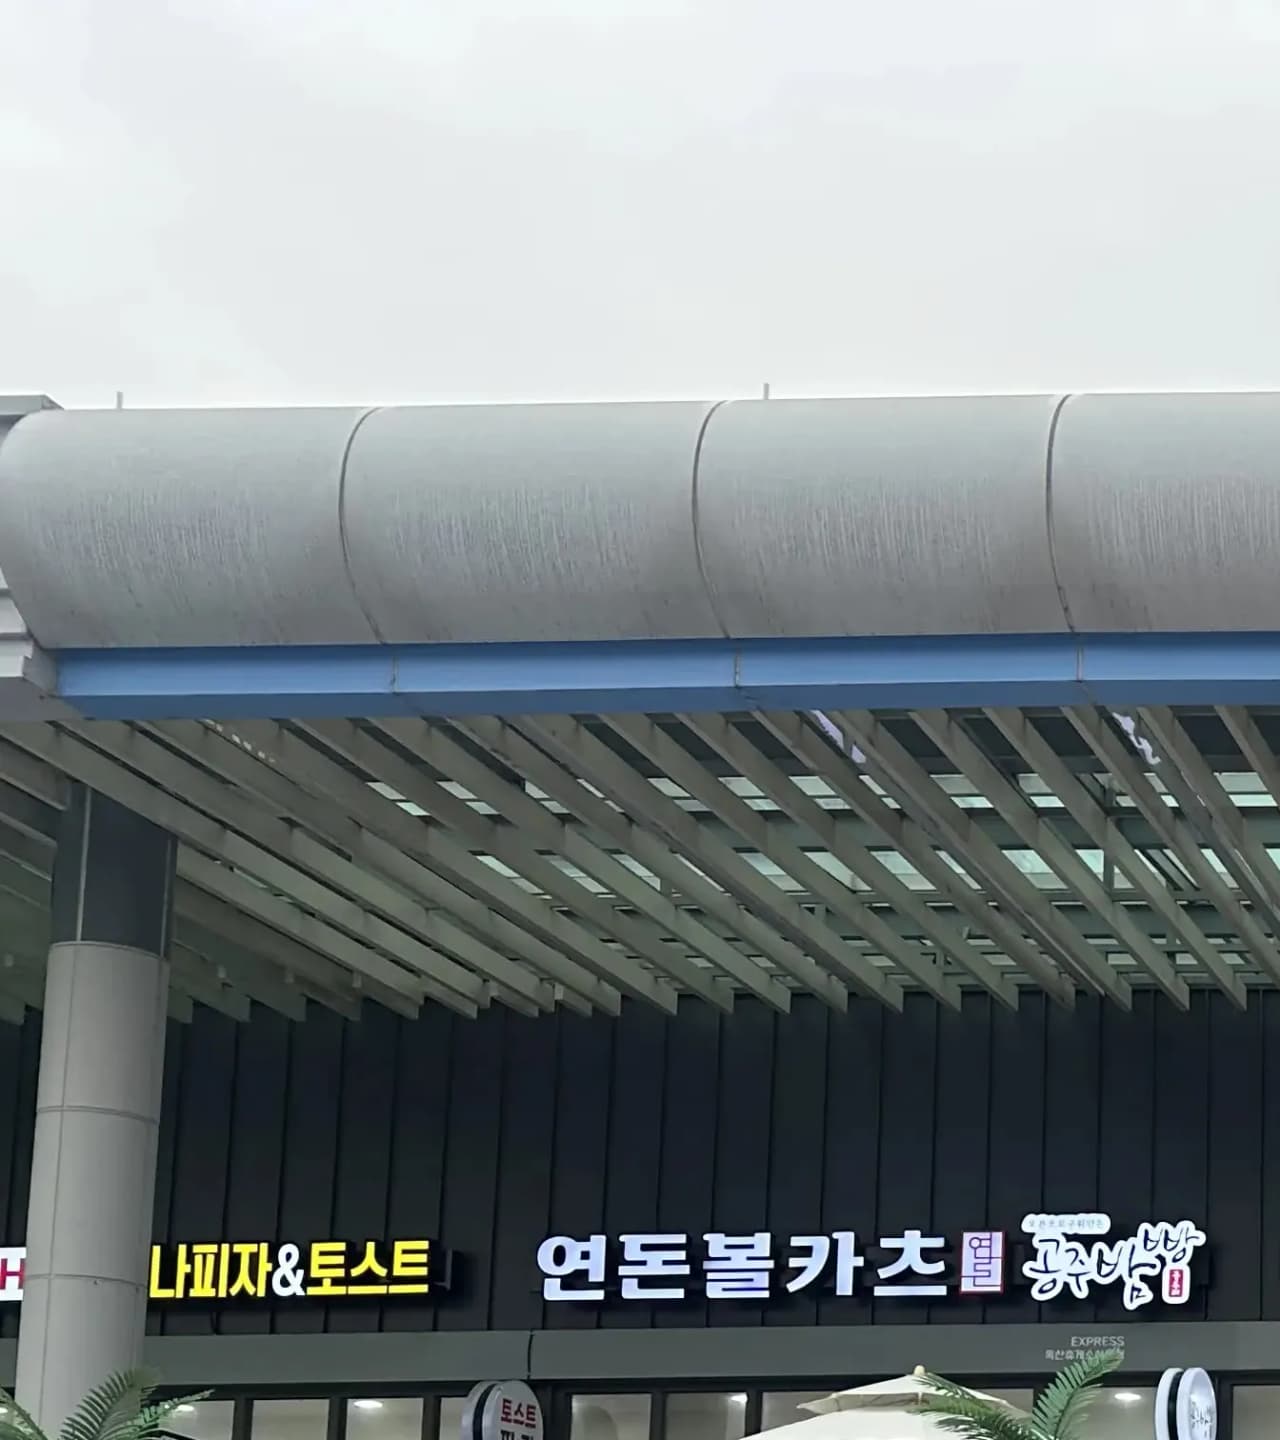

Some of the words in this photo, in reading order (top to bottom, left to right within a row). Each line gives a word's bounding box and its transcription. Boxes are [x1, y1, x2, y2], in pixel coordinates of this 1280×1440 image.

[537, 1231, 949, 1300] 연돈볼카츠
[1071, 1336, 1125, 1347] EXPRESS
[501, 1398, 537, 1429] 토스트
